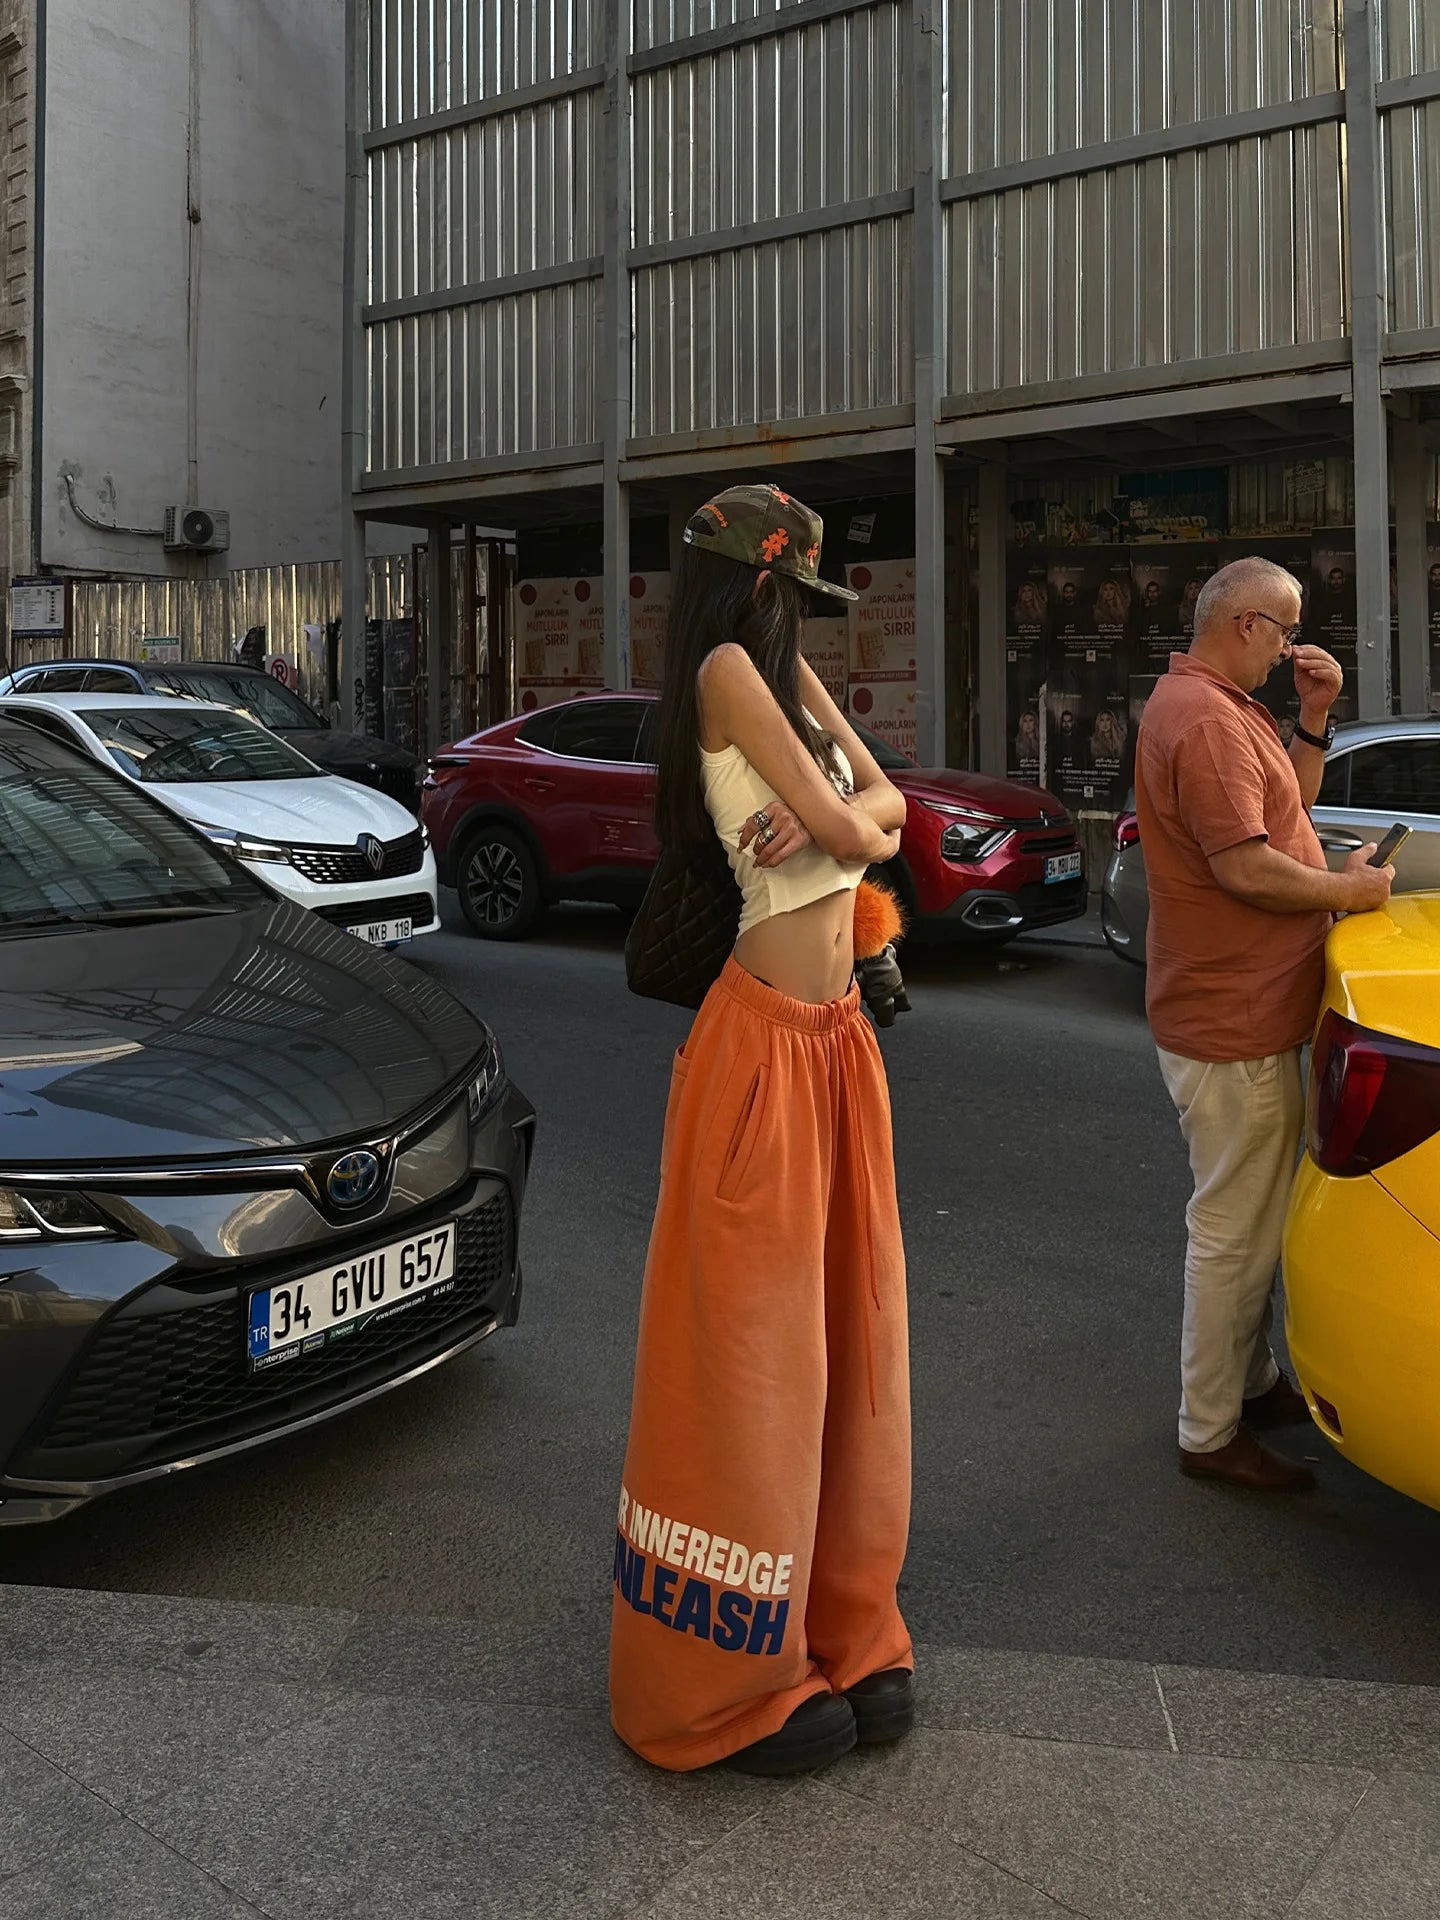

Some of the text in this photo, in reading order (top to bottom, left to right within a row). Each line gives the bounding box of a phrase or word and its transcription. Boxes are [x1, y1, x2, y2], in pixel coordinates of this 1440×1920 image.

[870, 593, 915, 604] JAPONLARIN
[859, 607, 916, 622] MUTLULUK
[527, 619, 569, 632] MUTLULUK
[884, 621, 915, 636] SIRRI
[545, 633, 569, 646] SIRRI
[368, 923, 387, 942] NKB
[395, 920, 410, 938] 118
[273, 1229, 449, 1340] 34 GVU 657
[253, 1326, 268, 1343] TR
[256, 1346, 299, 1368] enterprise
[629, 1499, 793, 1595] INNEREDGE
[613, 1527, 790, 1656] NLEASH
